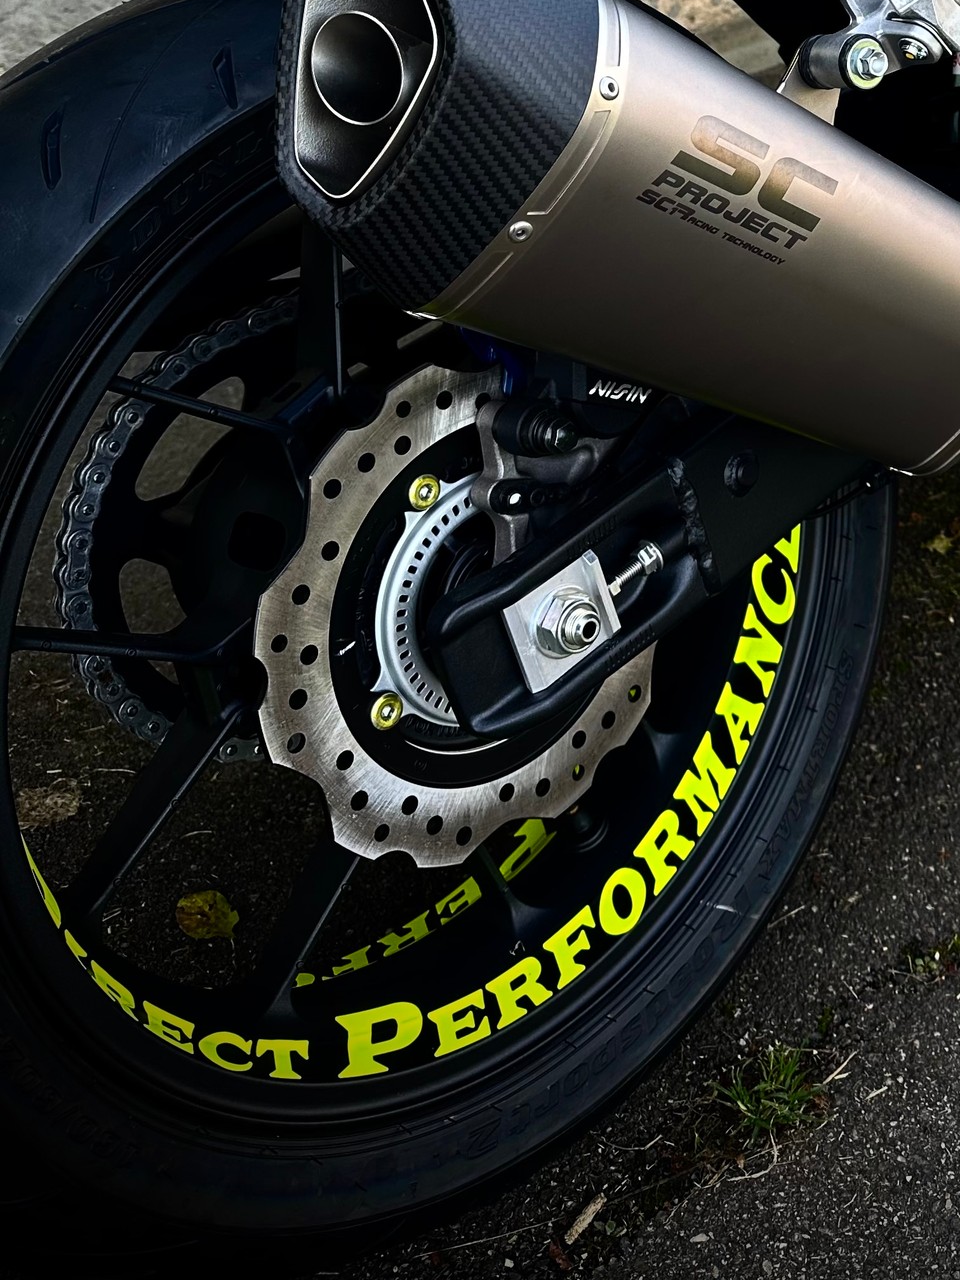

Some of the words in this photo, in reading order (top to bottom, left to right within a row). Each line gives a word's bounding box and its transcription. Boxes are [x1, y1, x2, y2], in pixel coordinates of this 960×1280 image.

[651, 169, 808, 250] PROJECT
[671, 115, 839, 233] SC
[722, 232, 785, 265] TECHNOLOGY
